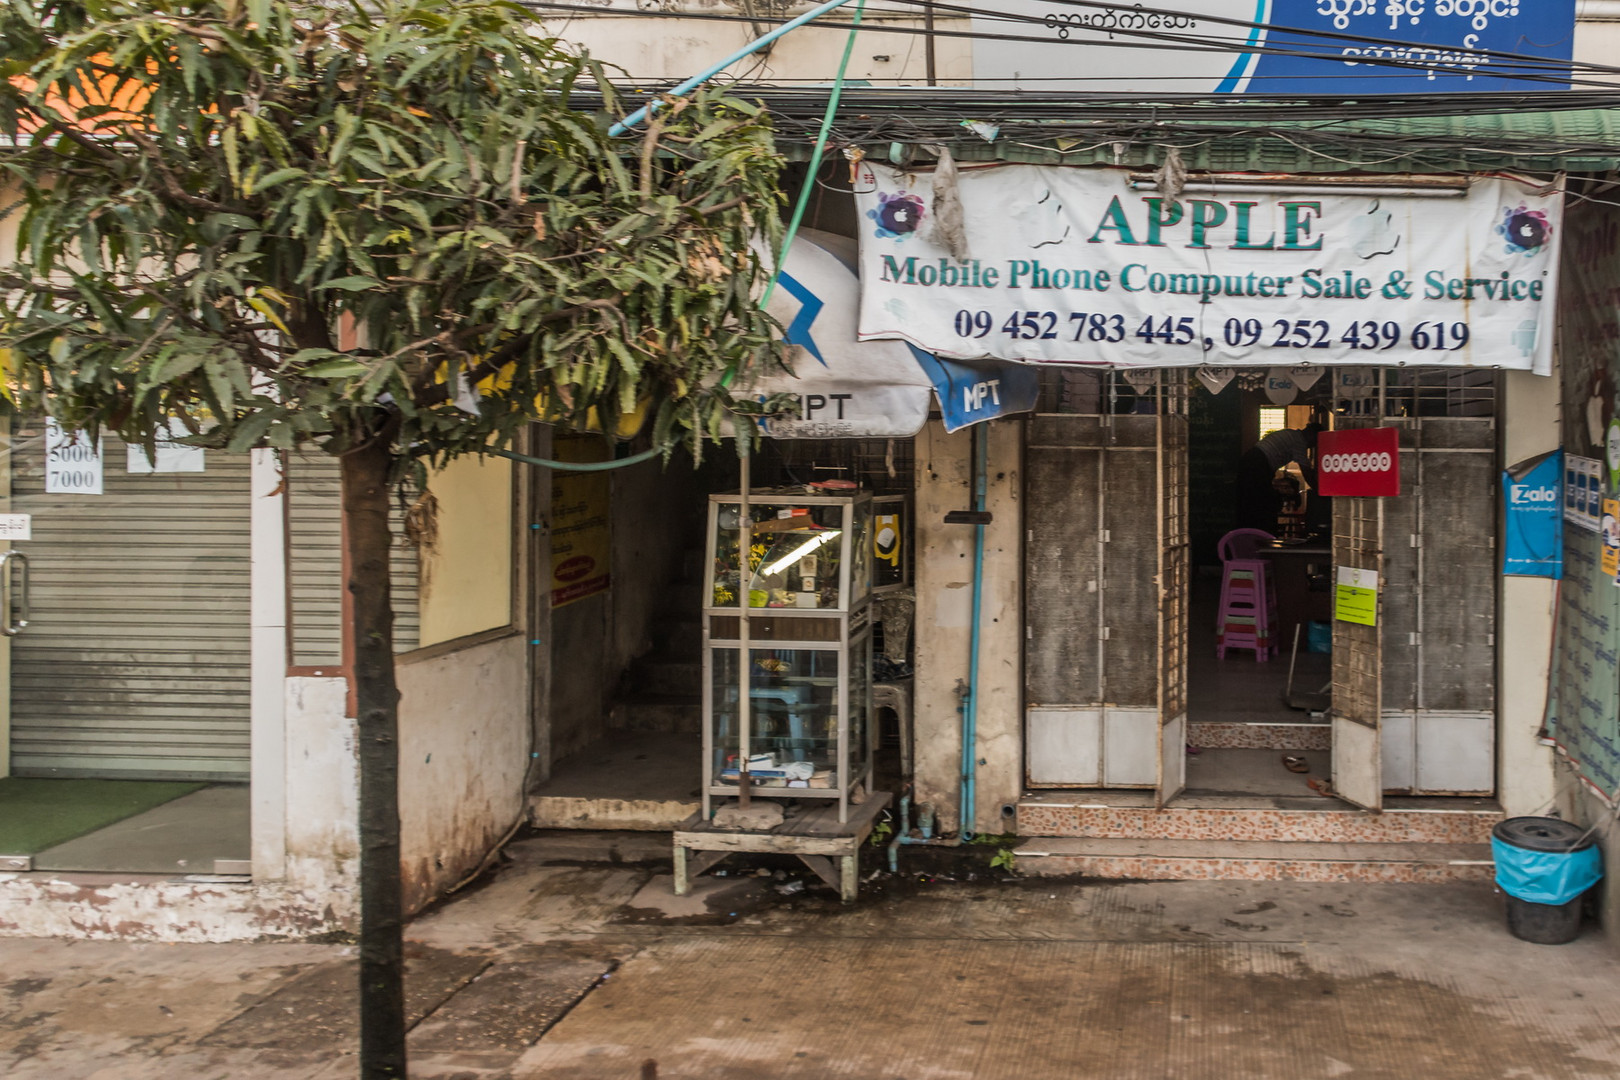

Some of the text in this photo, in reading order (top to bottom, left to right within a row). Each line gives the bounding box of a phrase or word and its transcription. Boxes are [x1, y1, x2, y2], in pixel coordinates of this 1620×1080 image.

[1087, 194, 1324, 251] APPLE
[880, 254, 1543, 304] Mobile Phone Computer Sale & Service
[954, 309, 993, 339] 09
[1002, 310, 1058, 340] 452
[1069, 312, 1126, 344] 783
[1224, 317, 1263, 348] 09
[1272, 319, 1331, 349] 252
[1341, 320, 1401, 351] 439
[1410, 321, 1470, 351] 619
[963, 379, 1000, 413] MPT
[51, 470, 94, 488] 7000
[1322, 451, 1391, 473] ooredoo
[1511, 484, 1557, 504] Zalo
